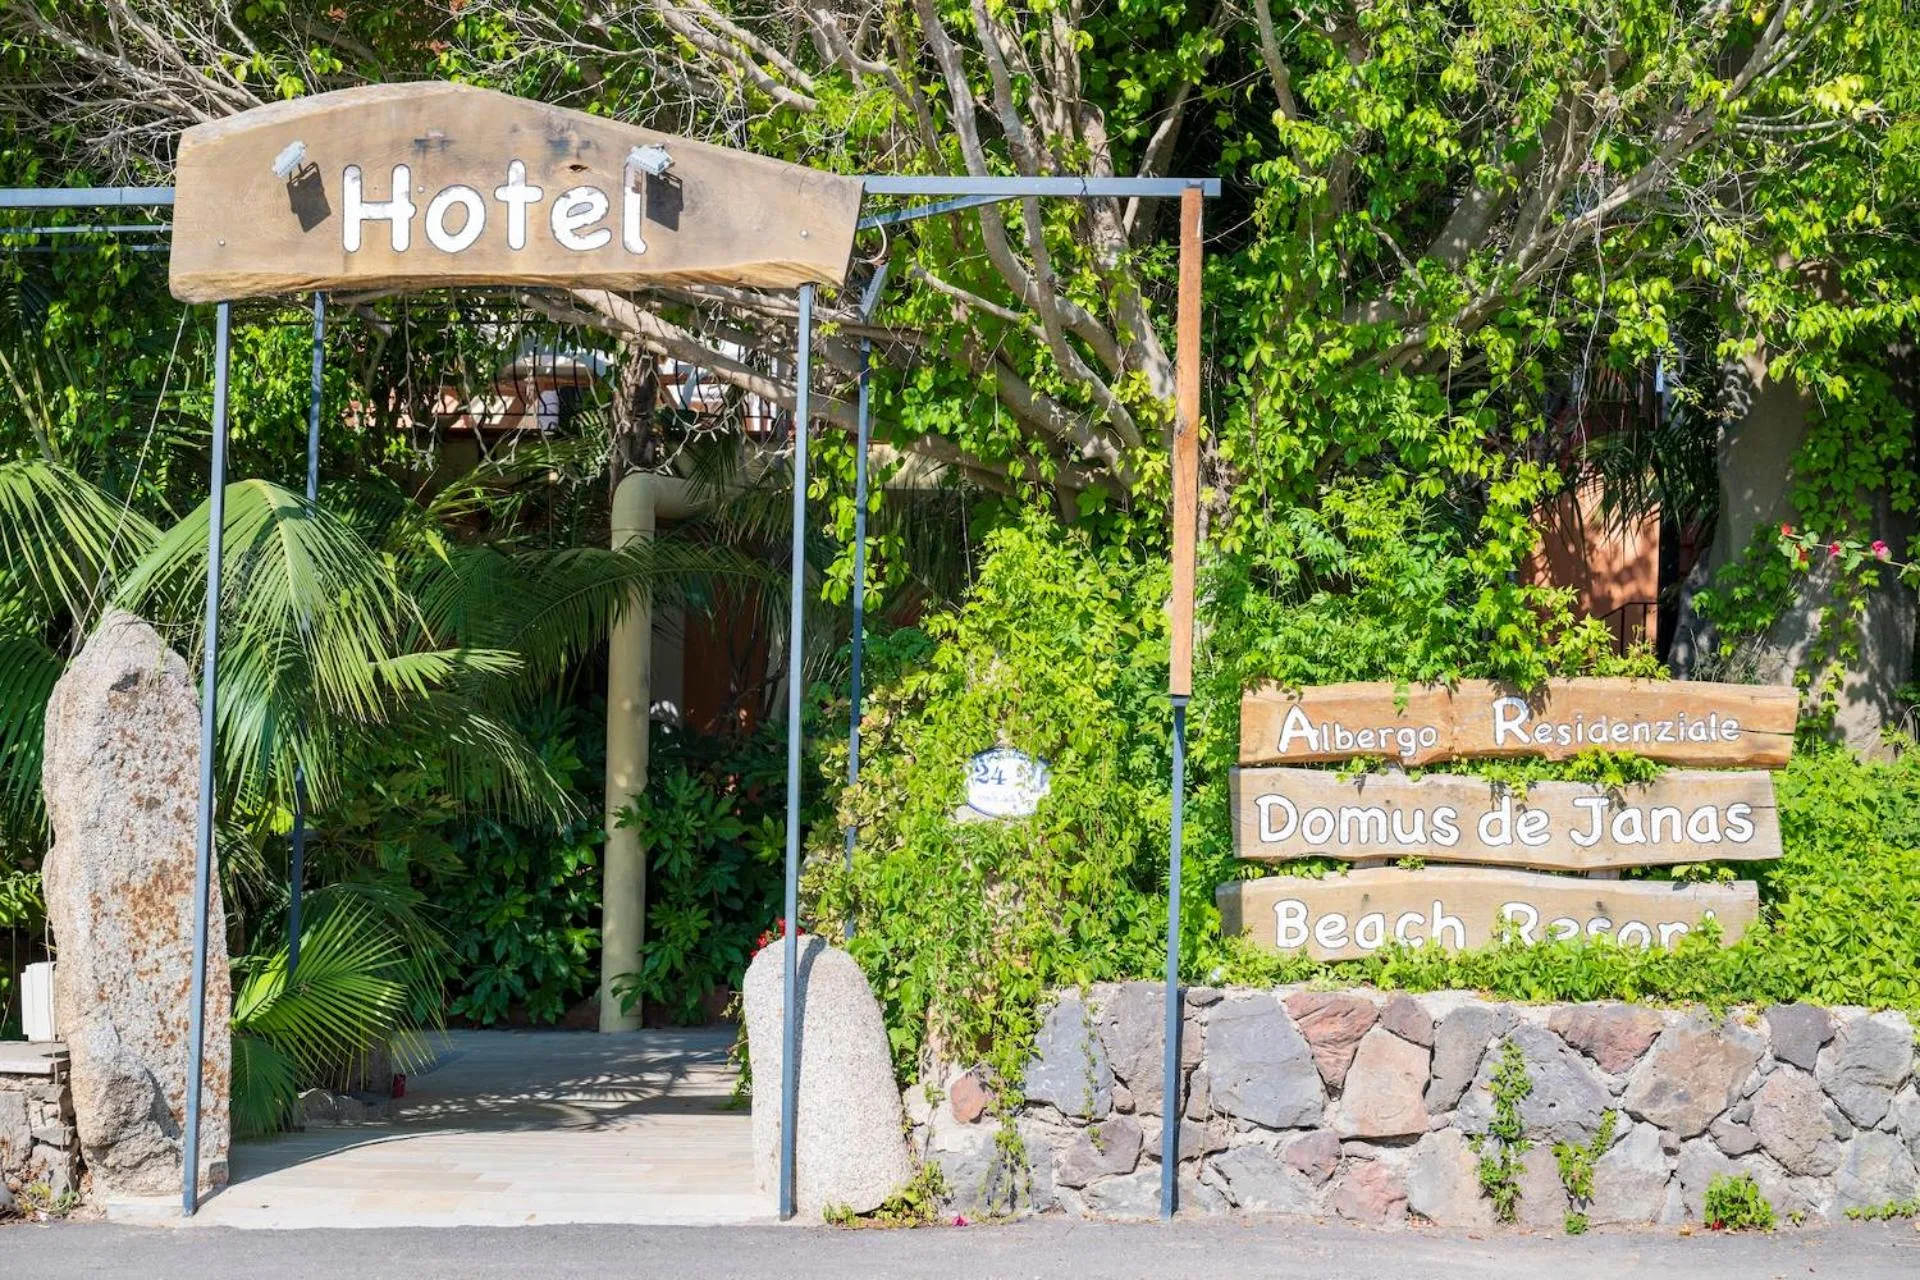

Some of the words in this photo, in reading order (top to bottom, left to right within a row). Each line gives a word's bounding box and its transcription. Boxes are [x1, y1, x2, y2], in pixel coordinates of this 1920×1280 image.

[342, 159, 647, 255] Hotel
[1278, 704, 1438, 757] Albergo
[1492, 697, 1741, 747] Residenziale
[1254, 793, 1461, 846] Domus
[1477, 795, 1551, 846] de
[1569, 796, 1756, 847] Janas
[1273, 899, 1467, 949] Beach
[1500, 900, 1717, 950] Resor
